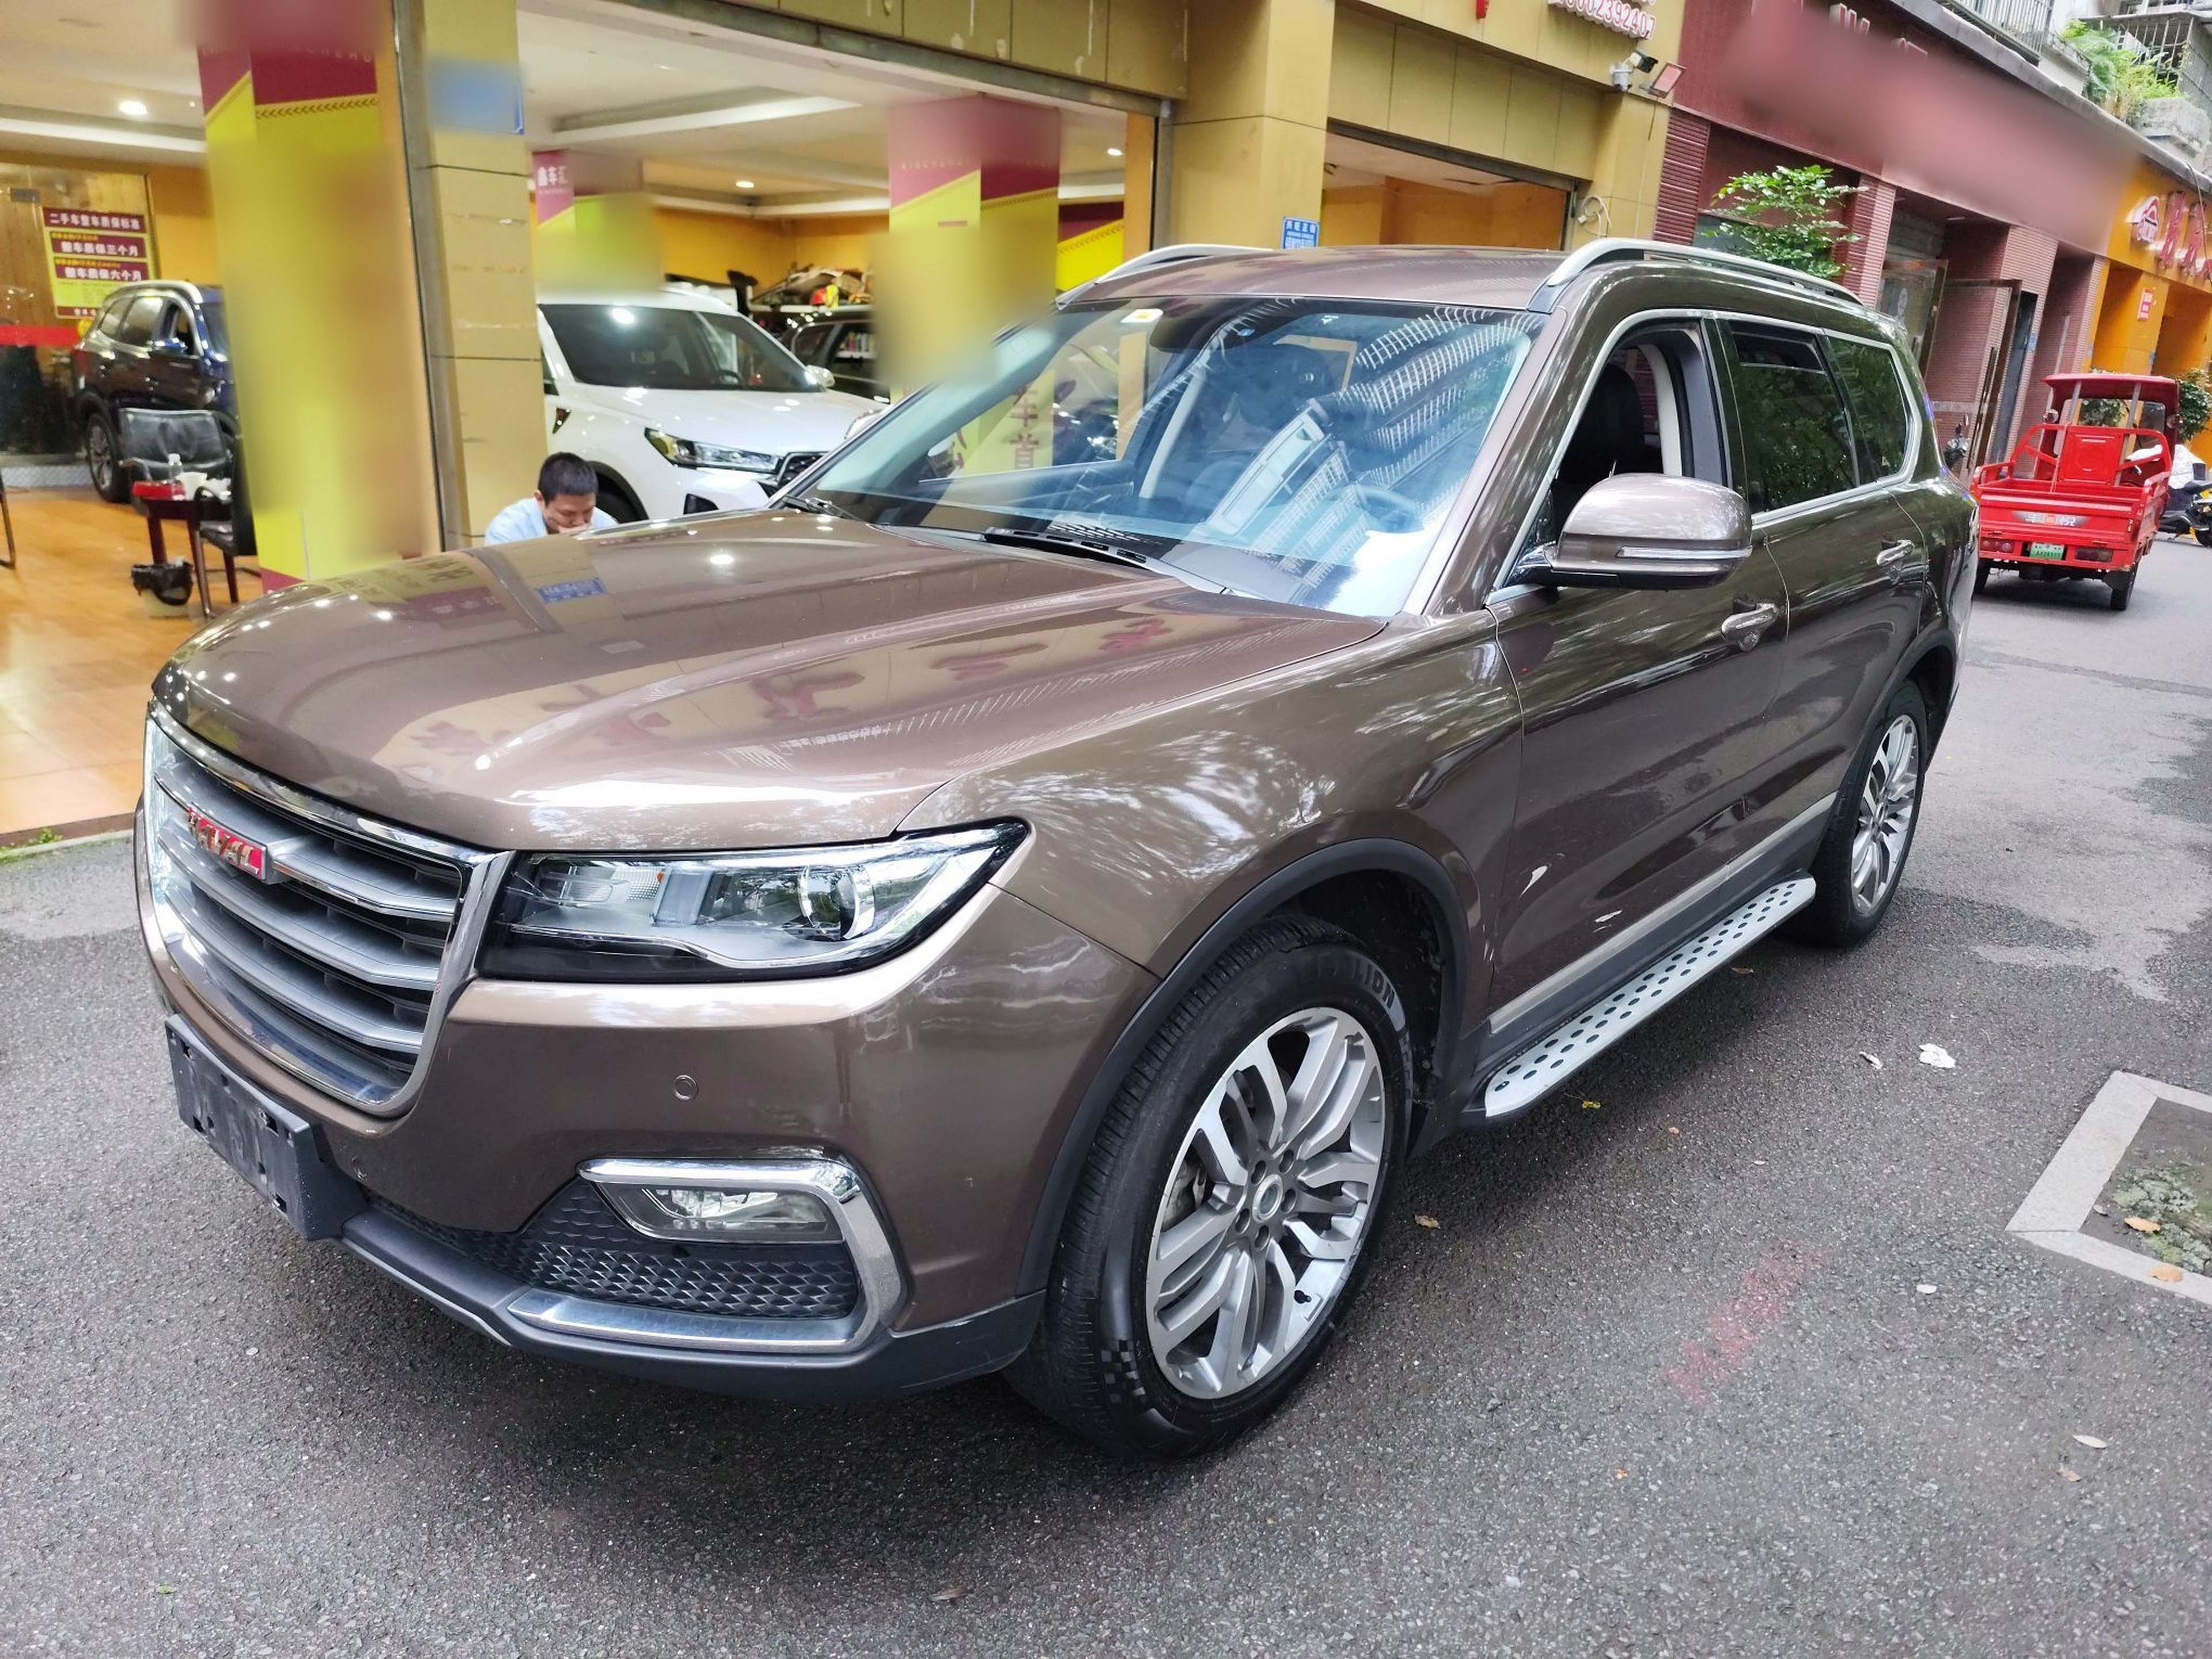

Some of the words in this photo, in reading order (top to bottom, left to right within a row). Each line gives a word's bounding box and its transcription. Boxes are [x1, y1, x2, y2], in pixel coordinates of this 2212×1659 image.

[61, 241, 139, 256] 整车质保三个月
[65, 267, 142, 281] 整车质保六个月
